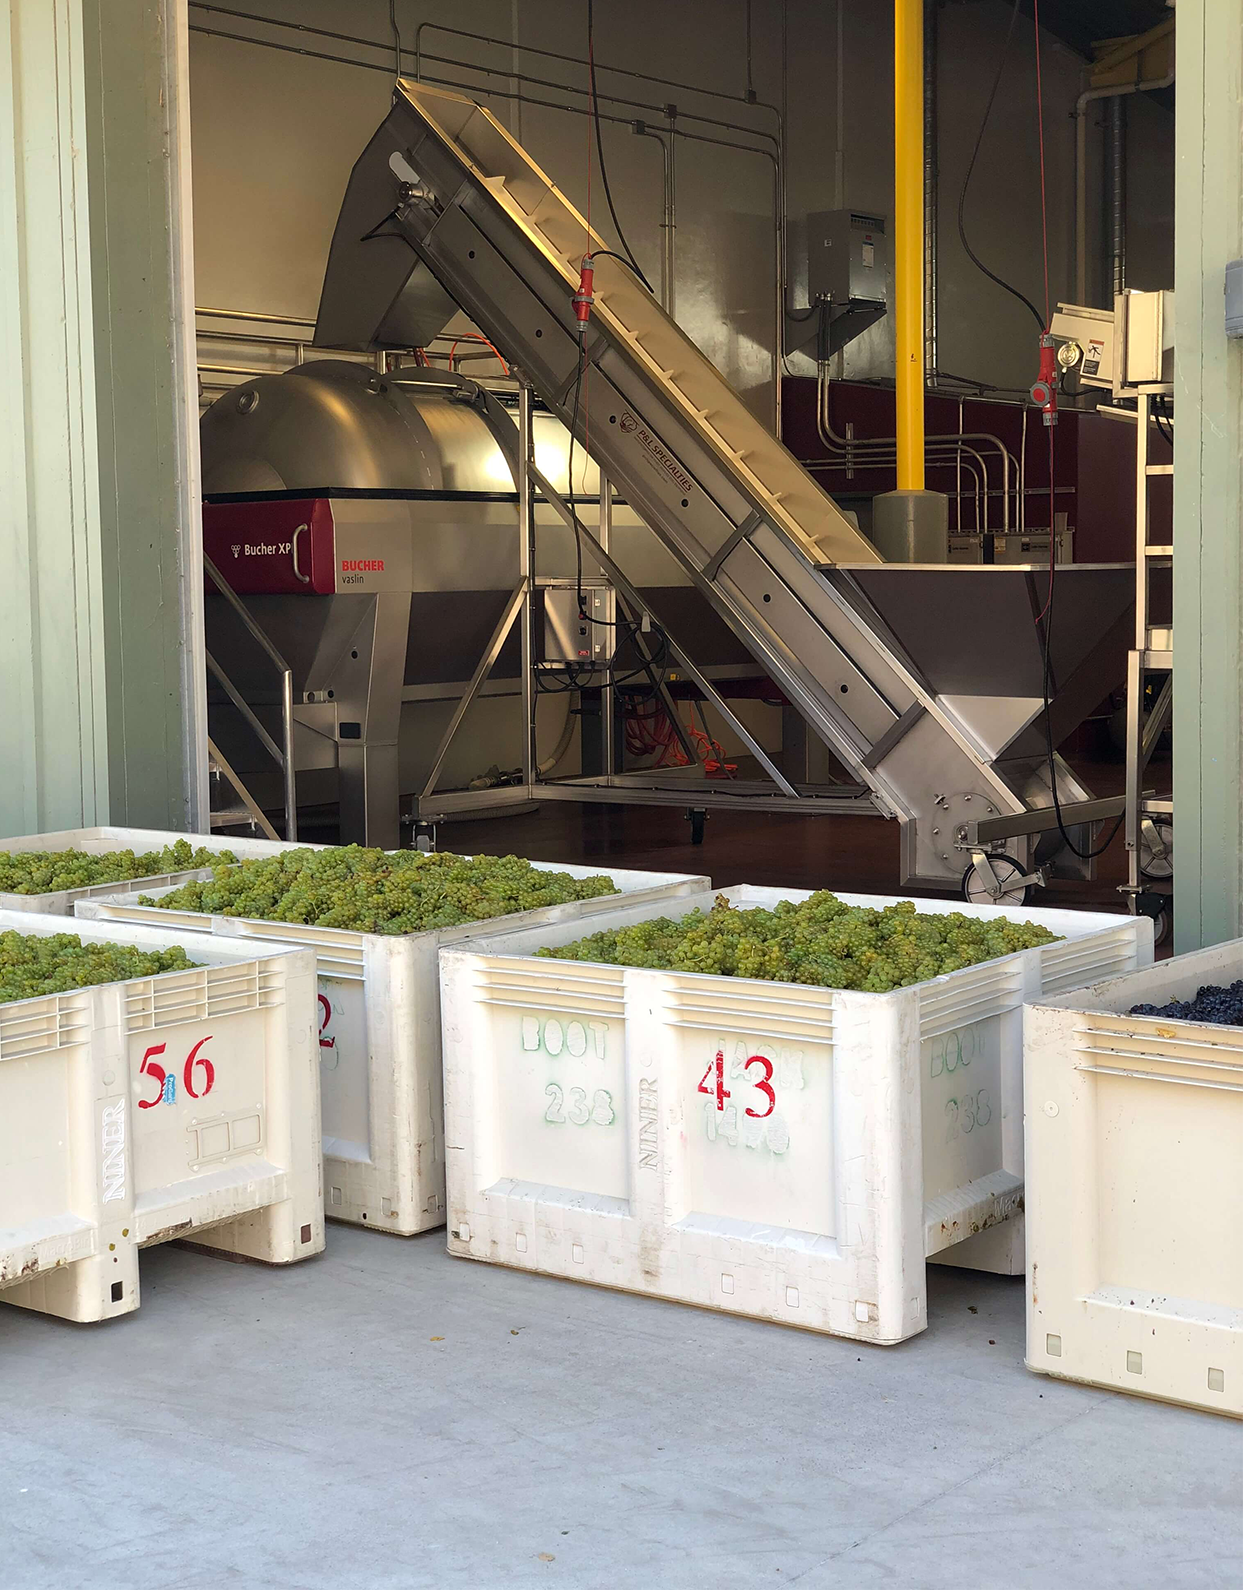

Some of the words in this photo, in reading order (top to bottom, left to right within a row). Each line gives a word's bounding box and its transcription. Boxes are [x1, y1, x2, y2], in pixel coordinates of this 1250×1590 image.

[652, 445, 693, 491] SPECIALTIES
[244, 542, 277, 556] Bucher
[278, 543, 291, 555] XP
[342, 560, 385, 571] BUCHER
[342, 574, 364, 584] vaslin
[521, 1014, 610, 1060] BOOT
[138, 1035, 216, 1109] 56
[697, 1050, 776, 1119] 43
[544, 1083, 616, 1126] 238
[638, 1076, 659, 1171] NINER
[103, 1098, 126, 1204] NINER
